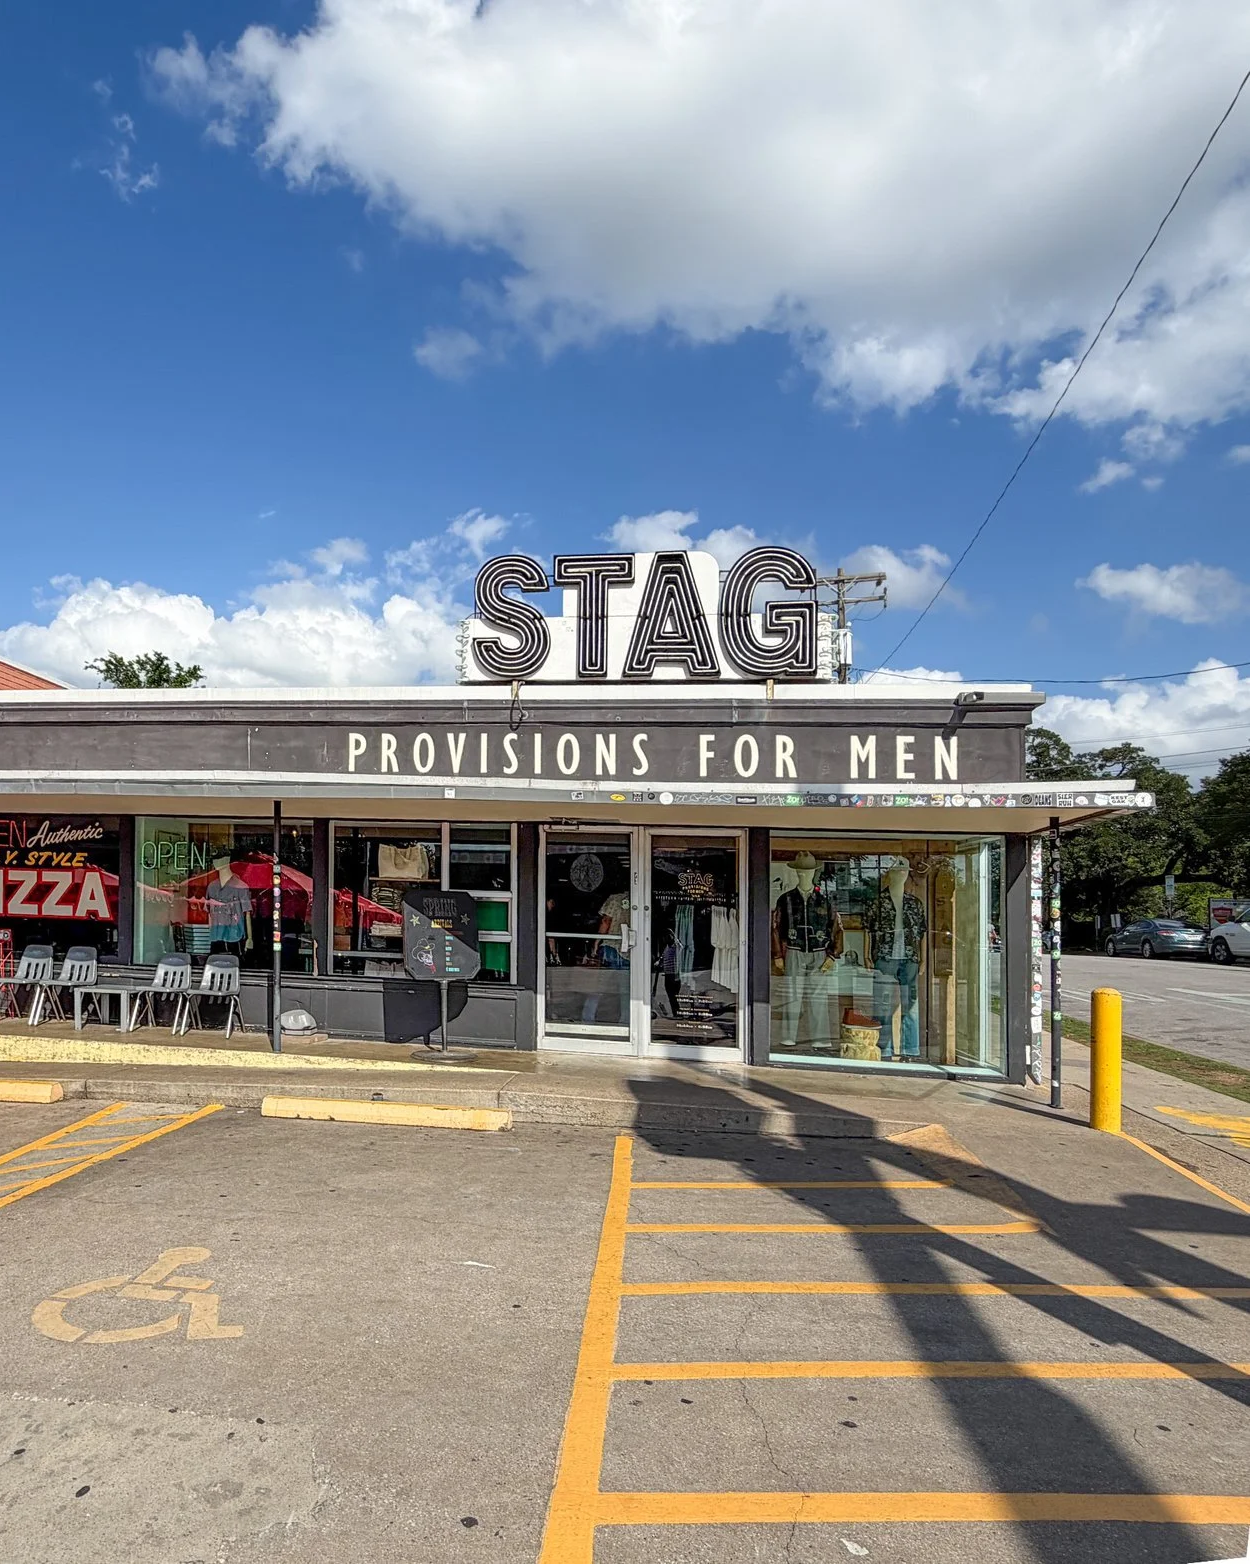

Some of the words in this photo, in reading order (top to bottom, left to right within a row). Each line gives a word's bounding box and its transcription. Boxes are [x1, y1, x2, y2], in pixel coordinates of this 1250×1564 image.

[472, 546, 819, 678] STAG
[348, 732, 650, 776] PROVISIONS
[699, 734, 798, 778] FOR
[849, 735, 958, 780] MEN
[26, 820, 103, 849] Authentic
[24, 851, 88, 867] STYLE
[141, 841, 207, 870] OPEN
[677, 872, 714, 887] STAG
[422, 897, 458, 918] SPRING
